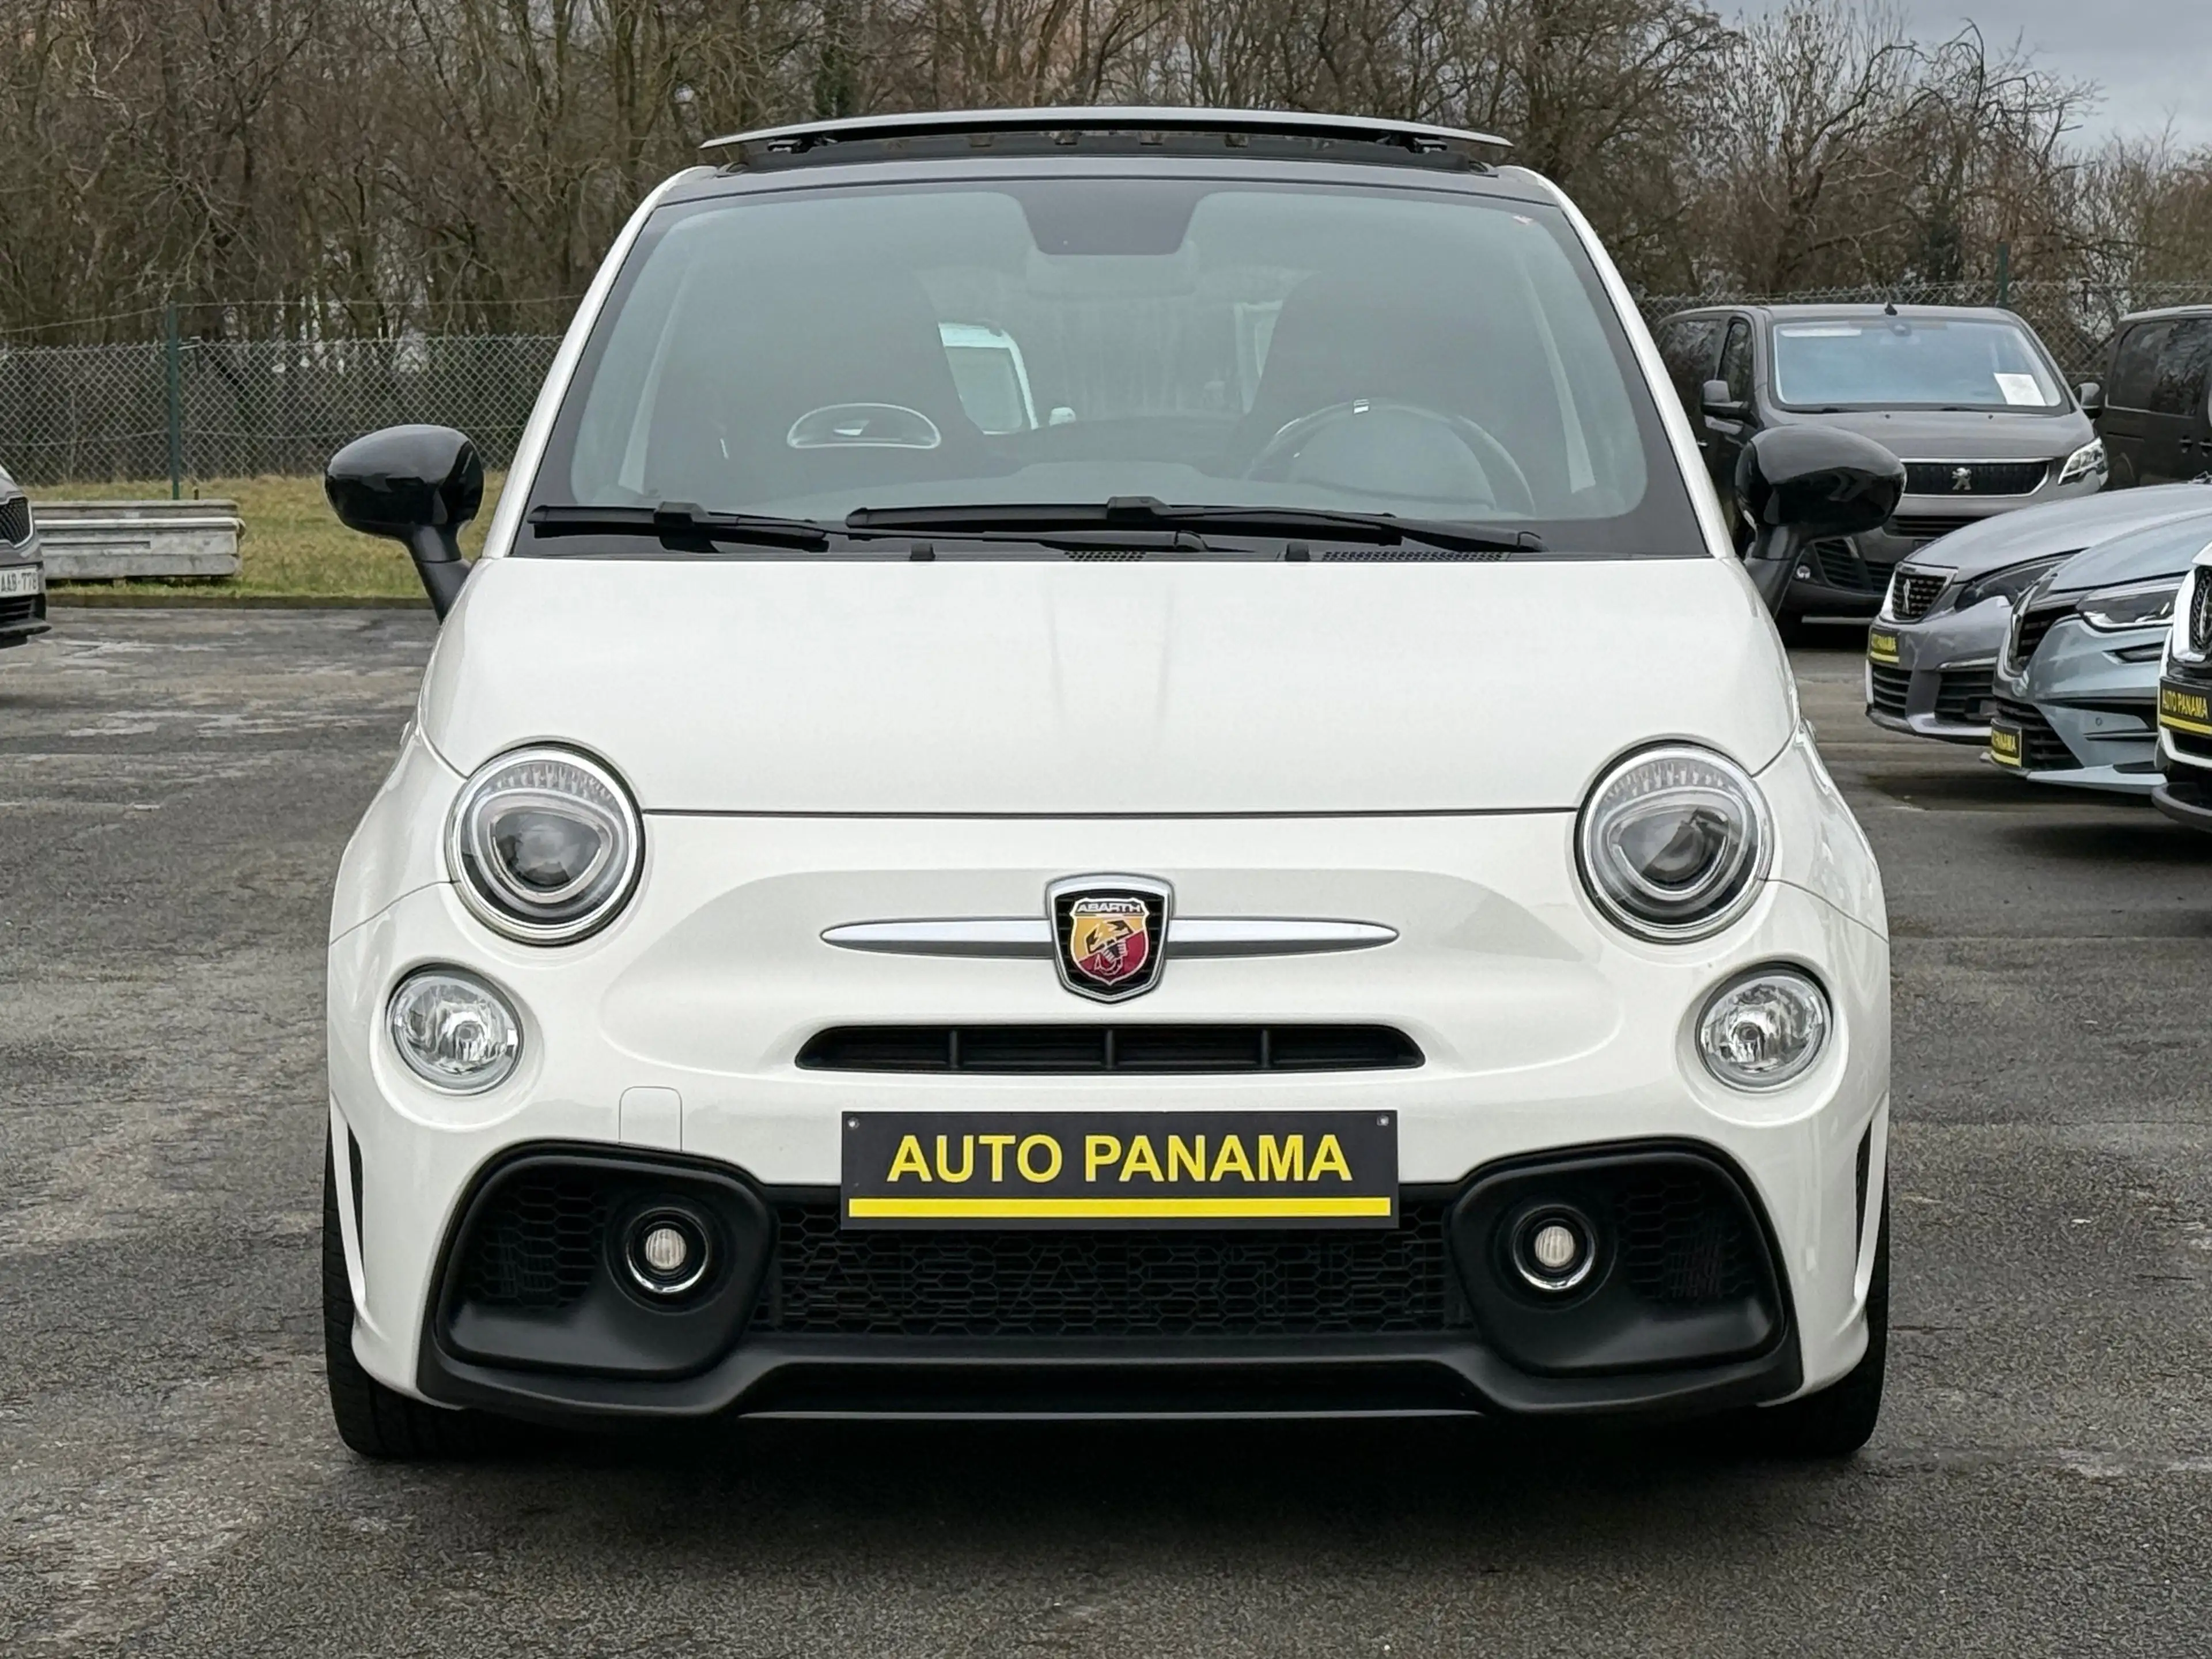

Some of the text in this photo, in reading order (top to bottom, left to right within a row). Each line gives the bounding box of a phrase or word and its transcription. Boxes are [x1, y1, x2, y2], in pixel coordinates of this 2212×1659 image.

[1077, 902, 1141, 912] ABARTH
[887, 1134, 1353, 1183] AUTO PANAMA
